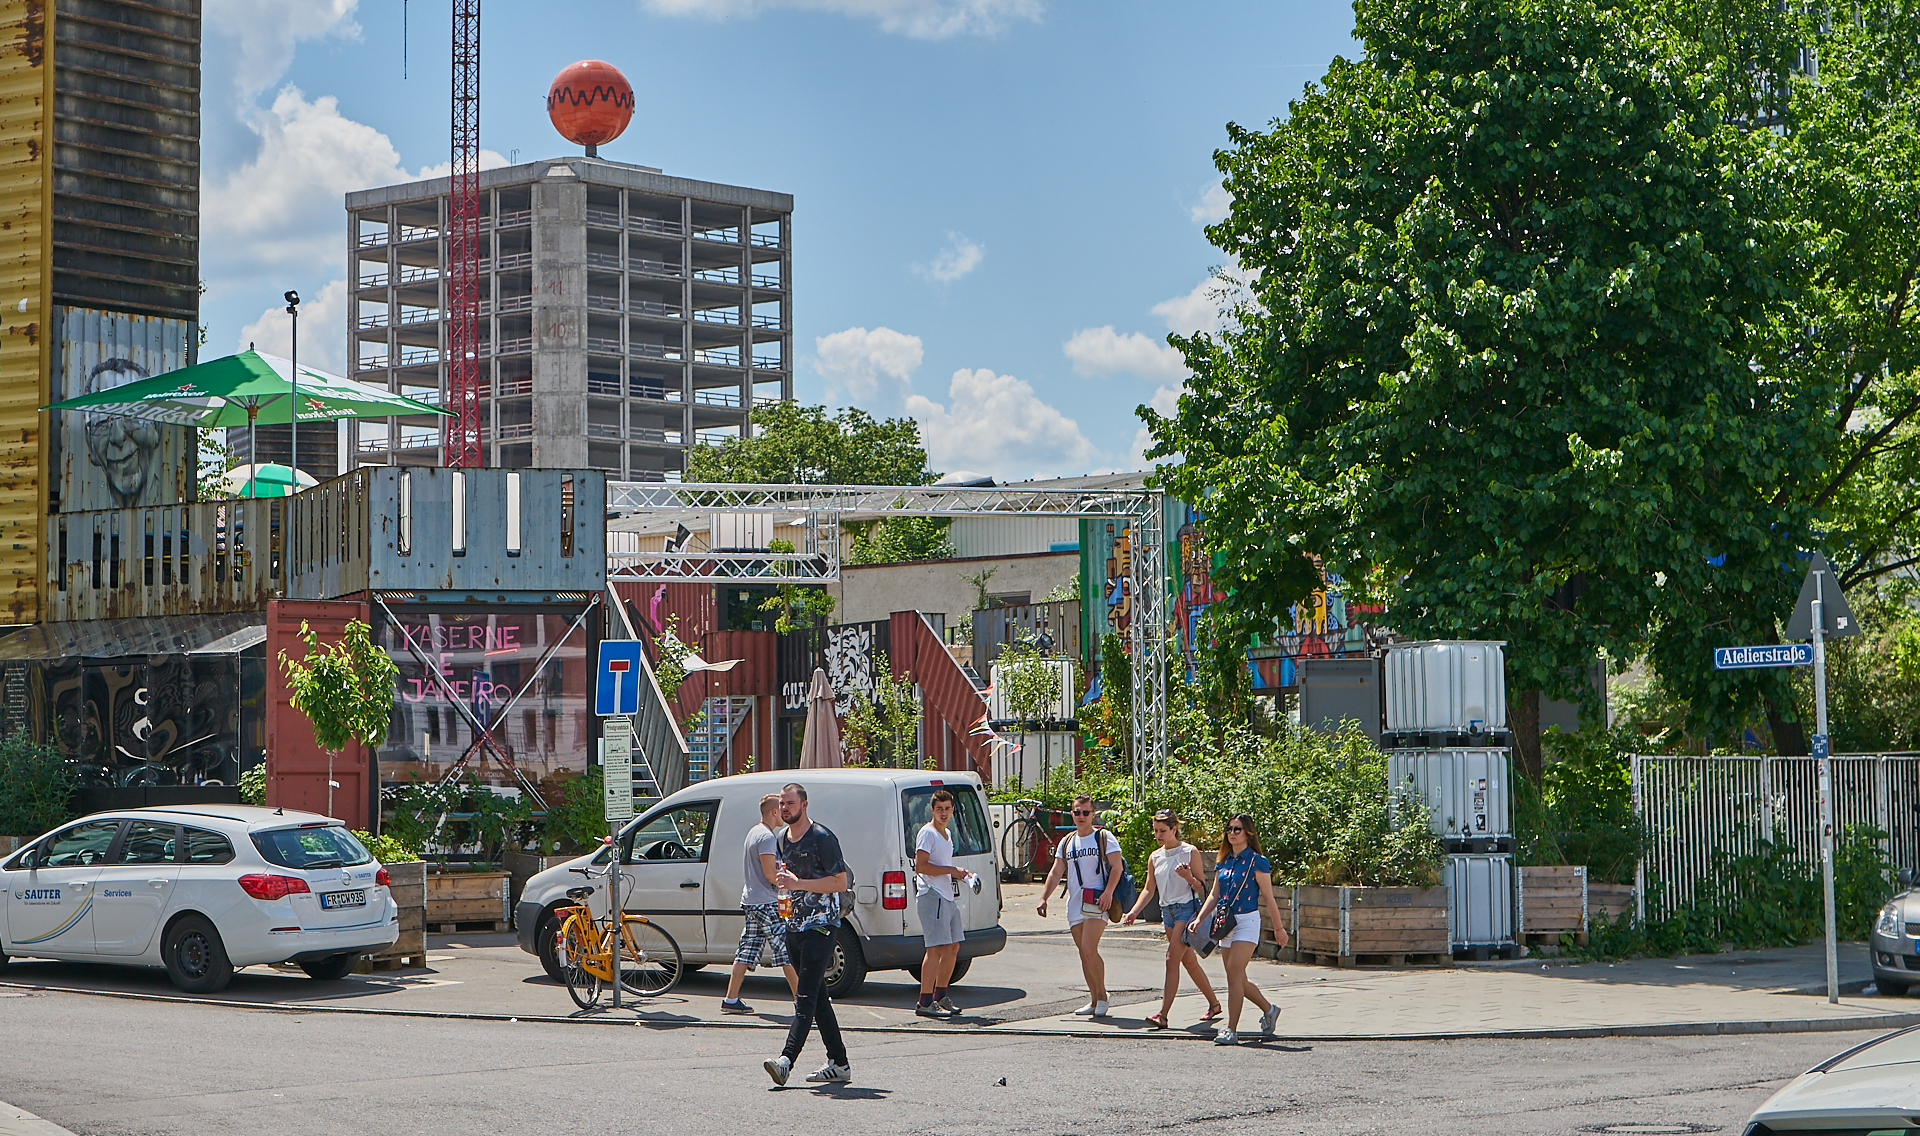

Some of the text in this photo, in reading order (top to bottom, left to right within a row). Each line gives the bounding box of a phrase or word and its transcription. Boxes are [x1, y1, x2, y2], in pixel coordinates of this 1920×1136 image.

[548, 280, 562, 295] 11
[548, 322, 566, 339] 10
[403, 624, 521, 650] KASERNE
[1722, 645, 1806, 664] Atelierstraße
[24, 889, 132, 899] SAUTER Services
[326, 894, 338, 905] FR
[351, 891, 364, 903] 935
